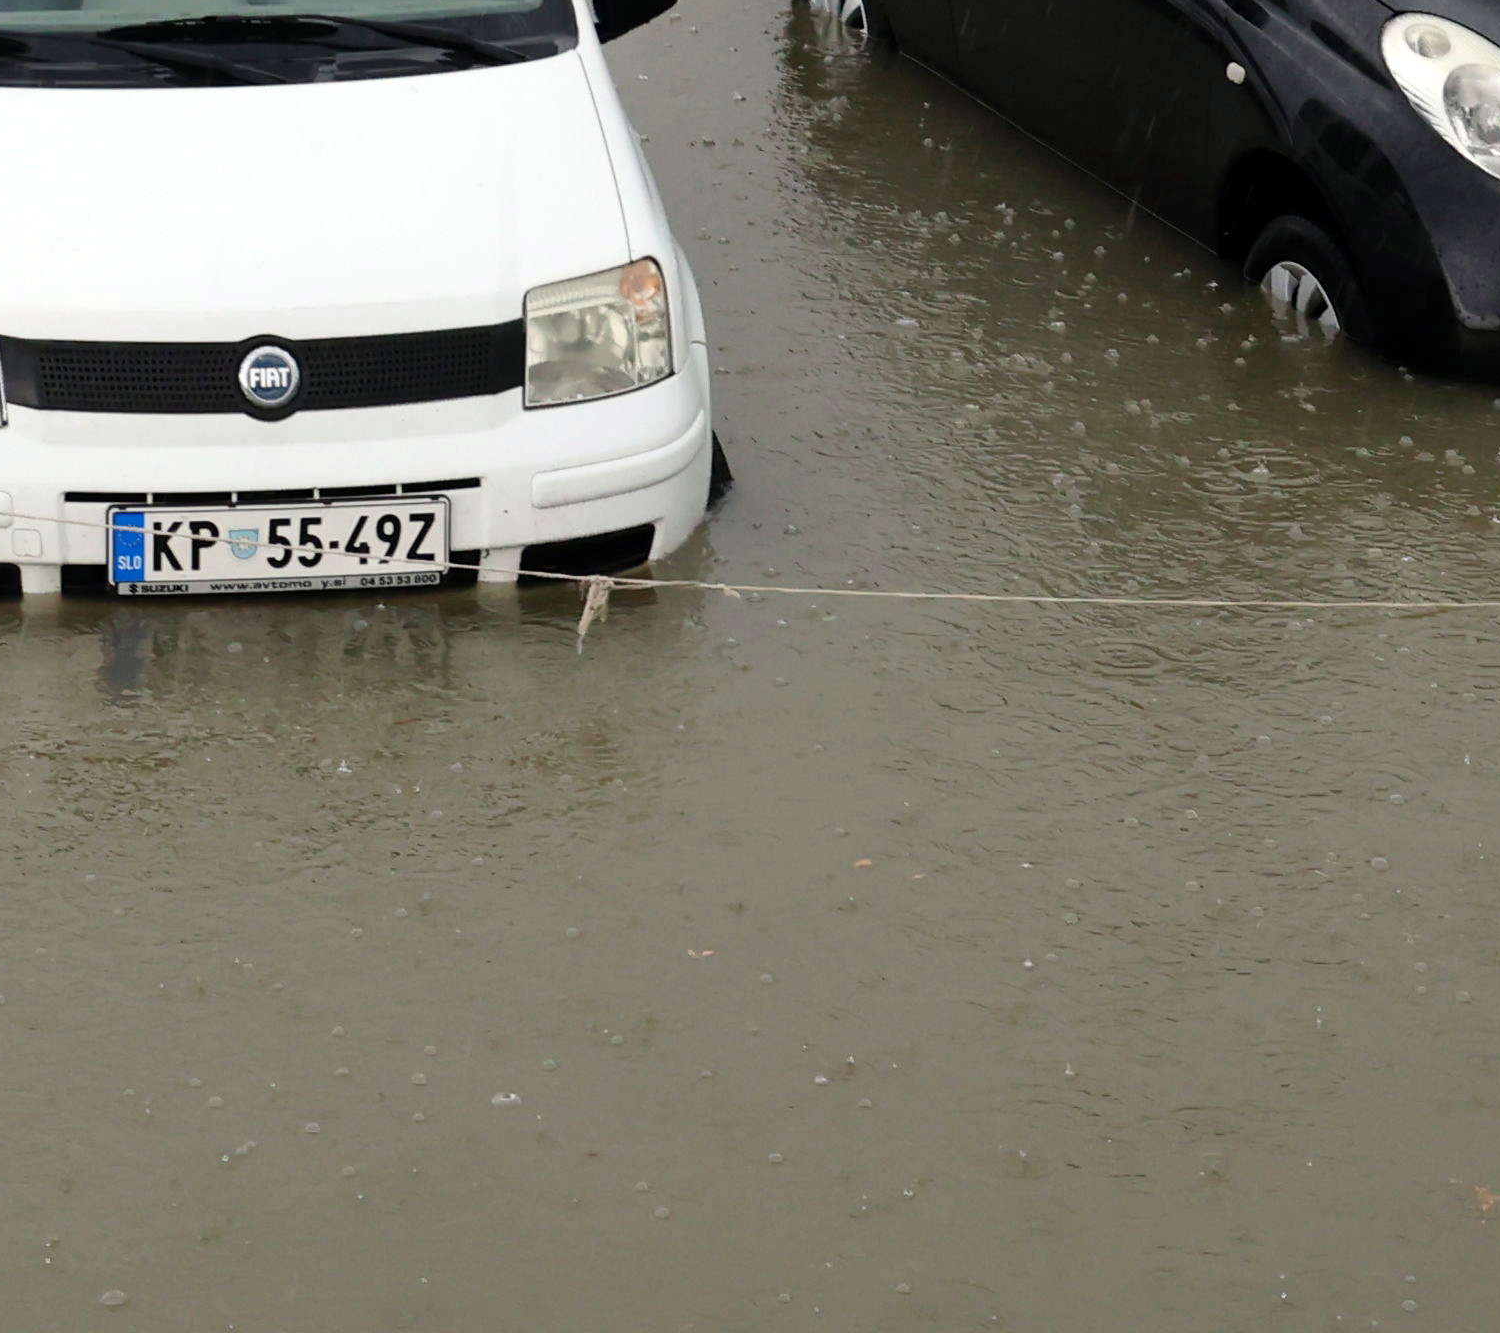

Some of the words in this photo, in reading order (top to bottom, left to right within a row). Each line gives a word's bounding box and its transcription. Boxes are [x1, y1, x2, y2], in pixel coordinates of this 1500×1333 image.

[249, 367, 290, 388] FIAT
[118, 555, 142, 571] SLO
[152, 520, 220, 572] KP
[140, 583, 189, 593] SUZUKI
